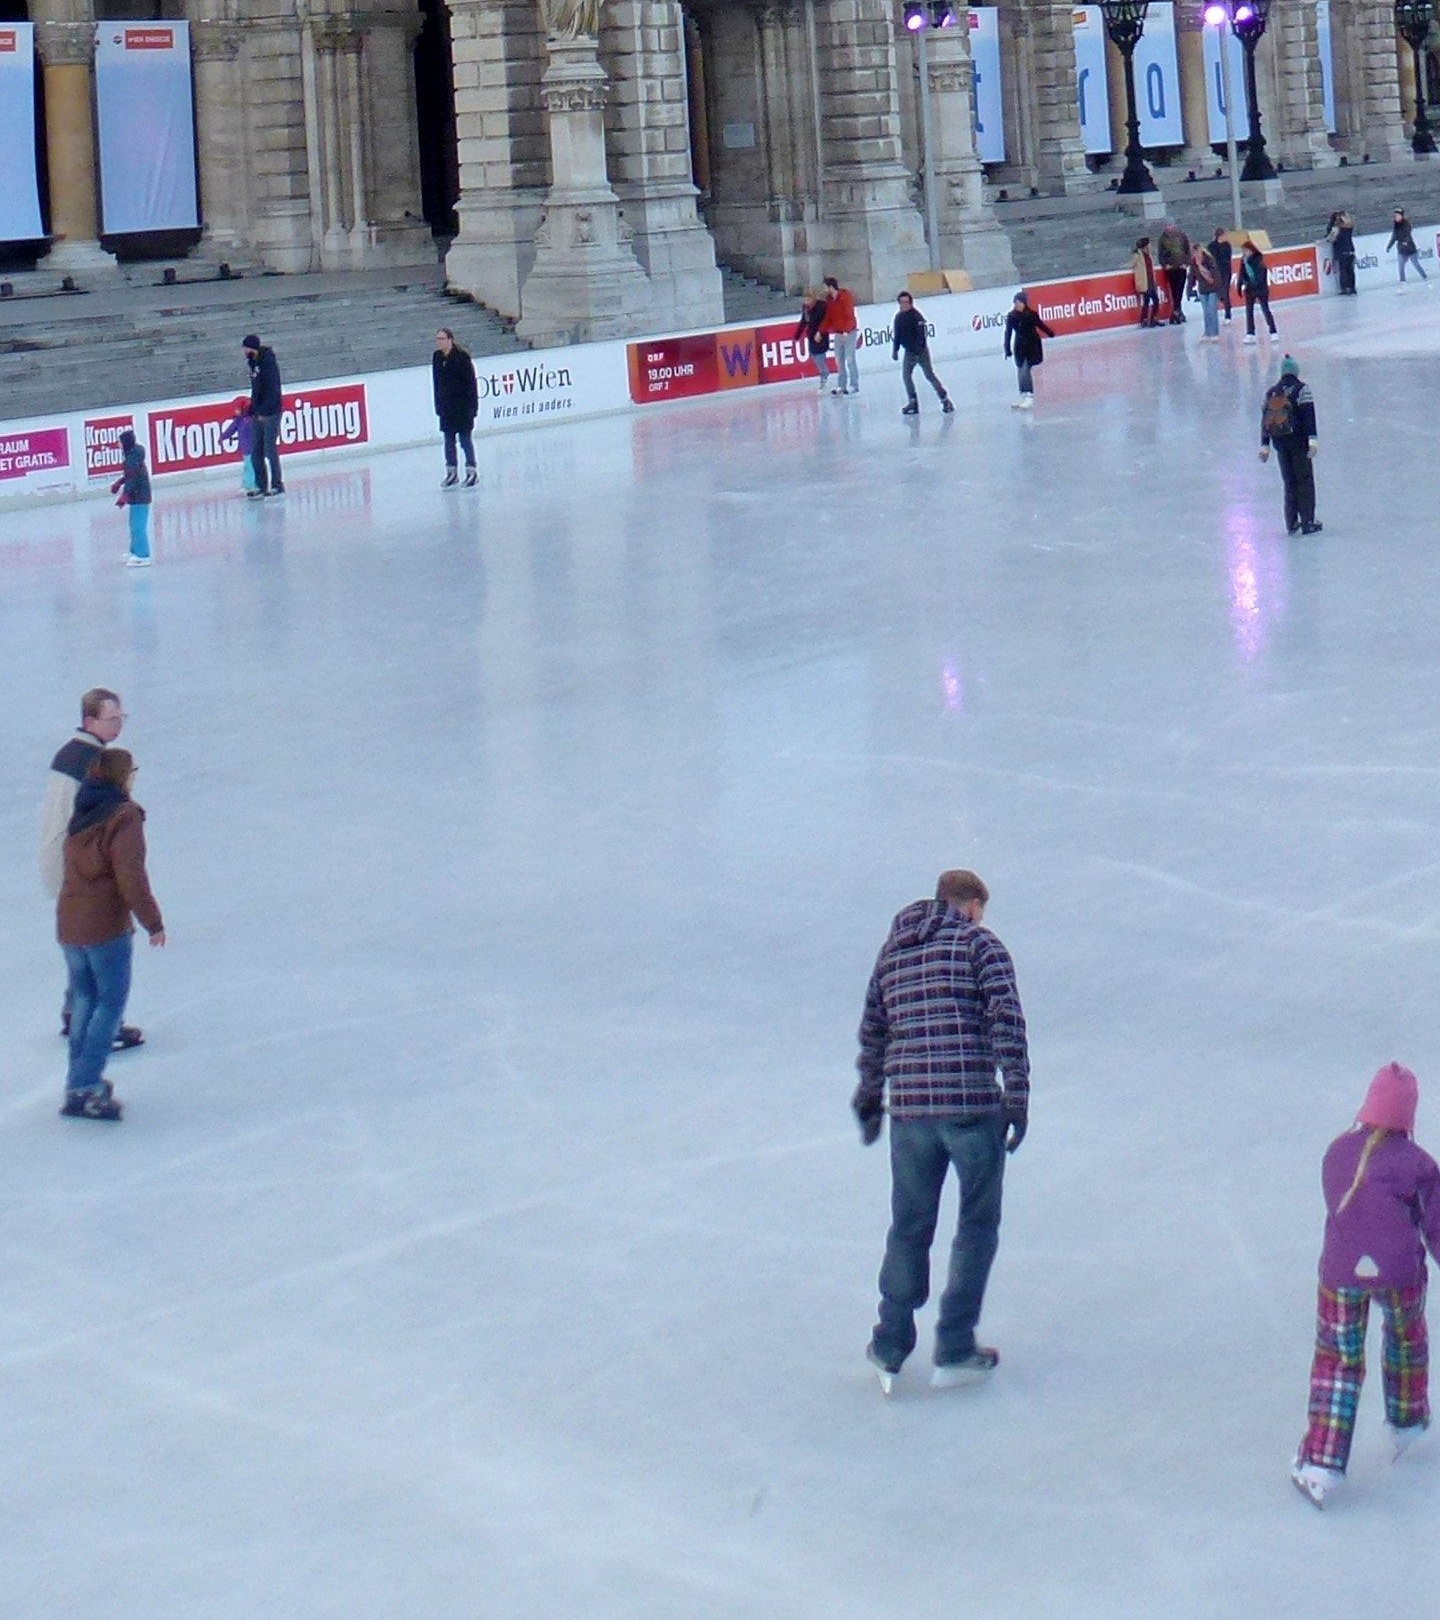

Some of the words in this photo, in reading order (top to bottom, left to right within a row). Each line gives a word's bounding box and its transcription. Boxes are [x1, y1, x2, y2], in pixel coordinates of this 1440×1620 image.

[1038, 300, 1076, 321] Immer
[1078, 295, 1103, 315] dem
[1105, 292, 1138, 313] Strom
[865, 325, 894, 347] Bank
[762, 332, 836, 369] HEUE
[516, 363, 572, 393] Wien
[648, 367, 672, 381] 19.00
[674, 364, 694, 378] UHR
[276, 398, 360, 446] eitung
[493, 405, 518, 419] Wien
[522, 402, 535, 415] ist
[17, 452, 57, 468] GRATIS.
